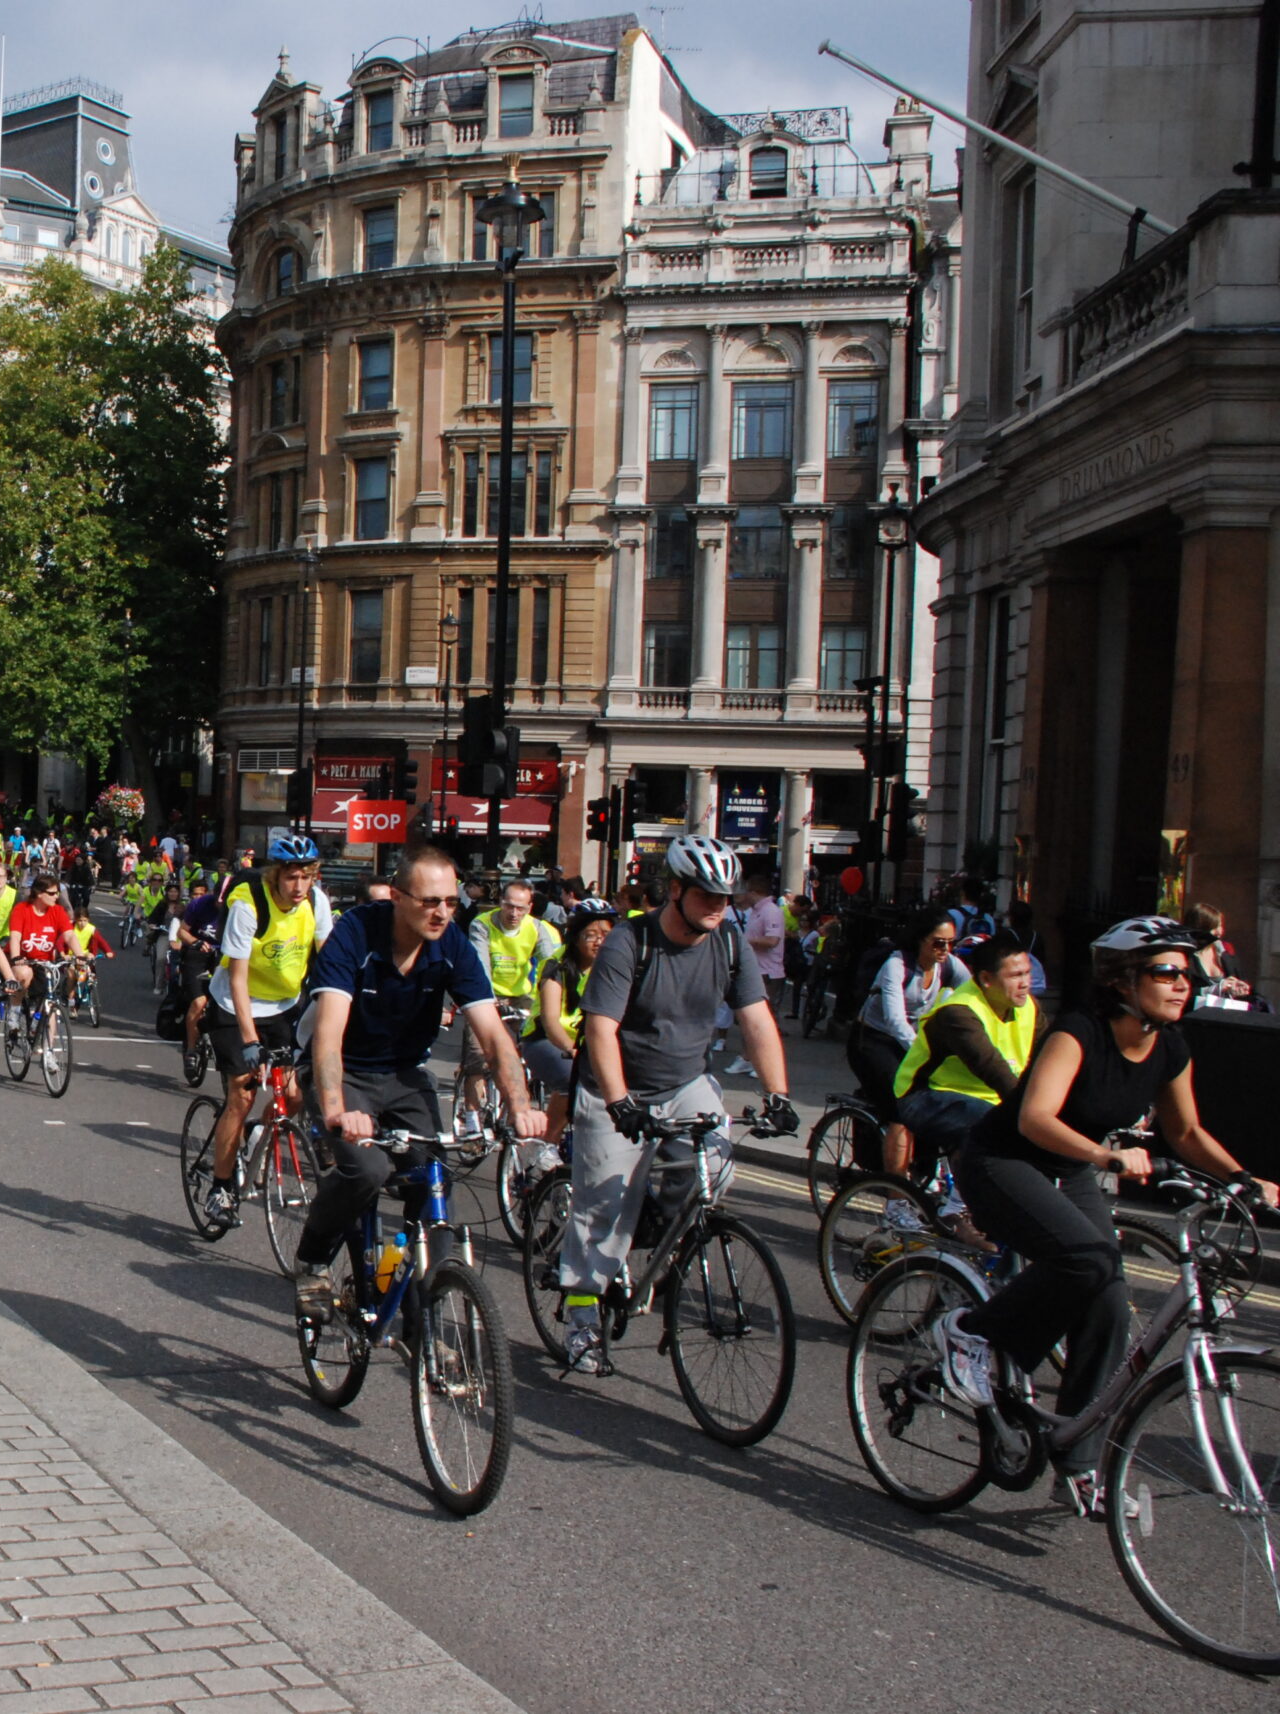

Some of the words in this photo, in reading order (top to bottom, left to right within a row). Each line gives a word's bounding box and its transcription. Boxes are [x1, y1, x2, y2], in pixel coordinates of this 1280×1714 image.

[1061, 427, 1175, 504] DRUMMONDS
[330, 765, 348, 778] PRET
[350, 766, 357, 778] A
[360, 765, 390, 778] MANG
[1172, 752, 1189, 783] 49
[352, 813, 401, 831] STOP
